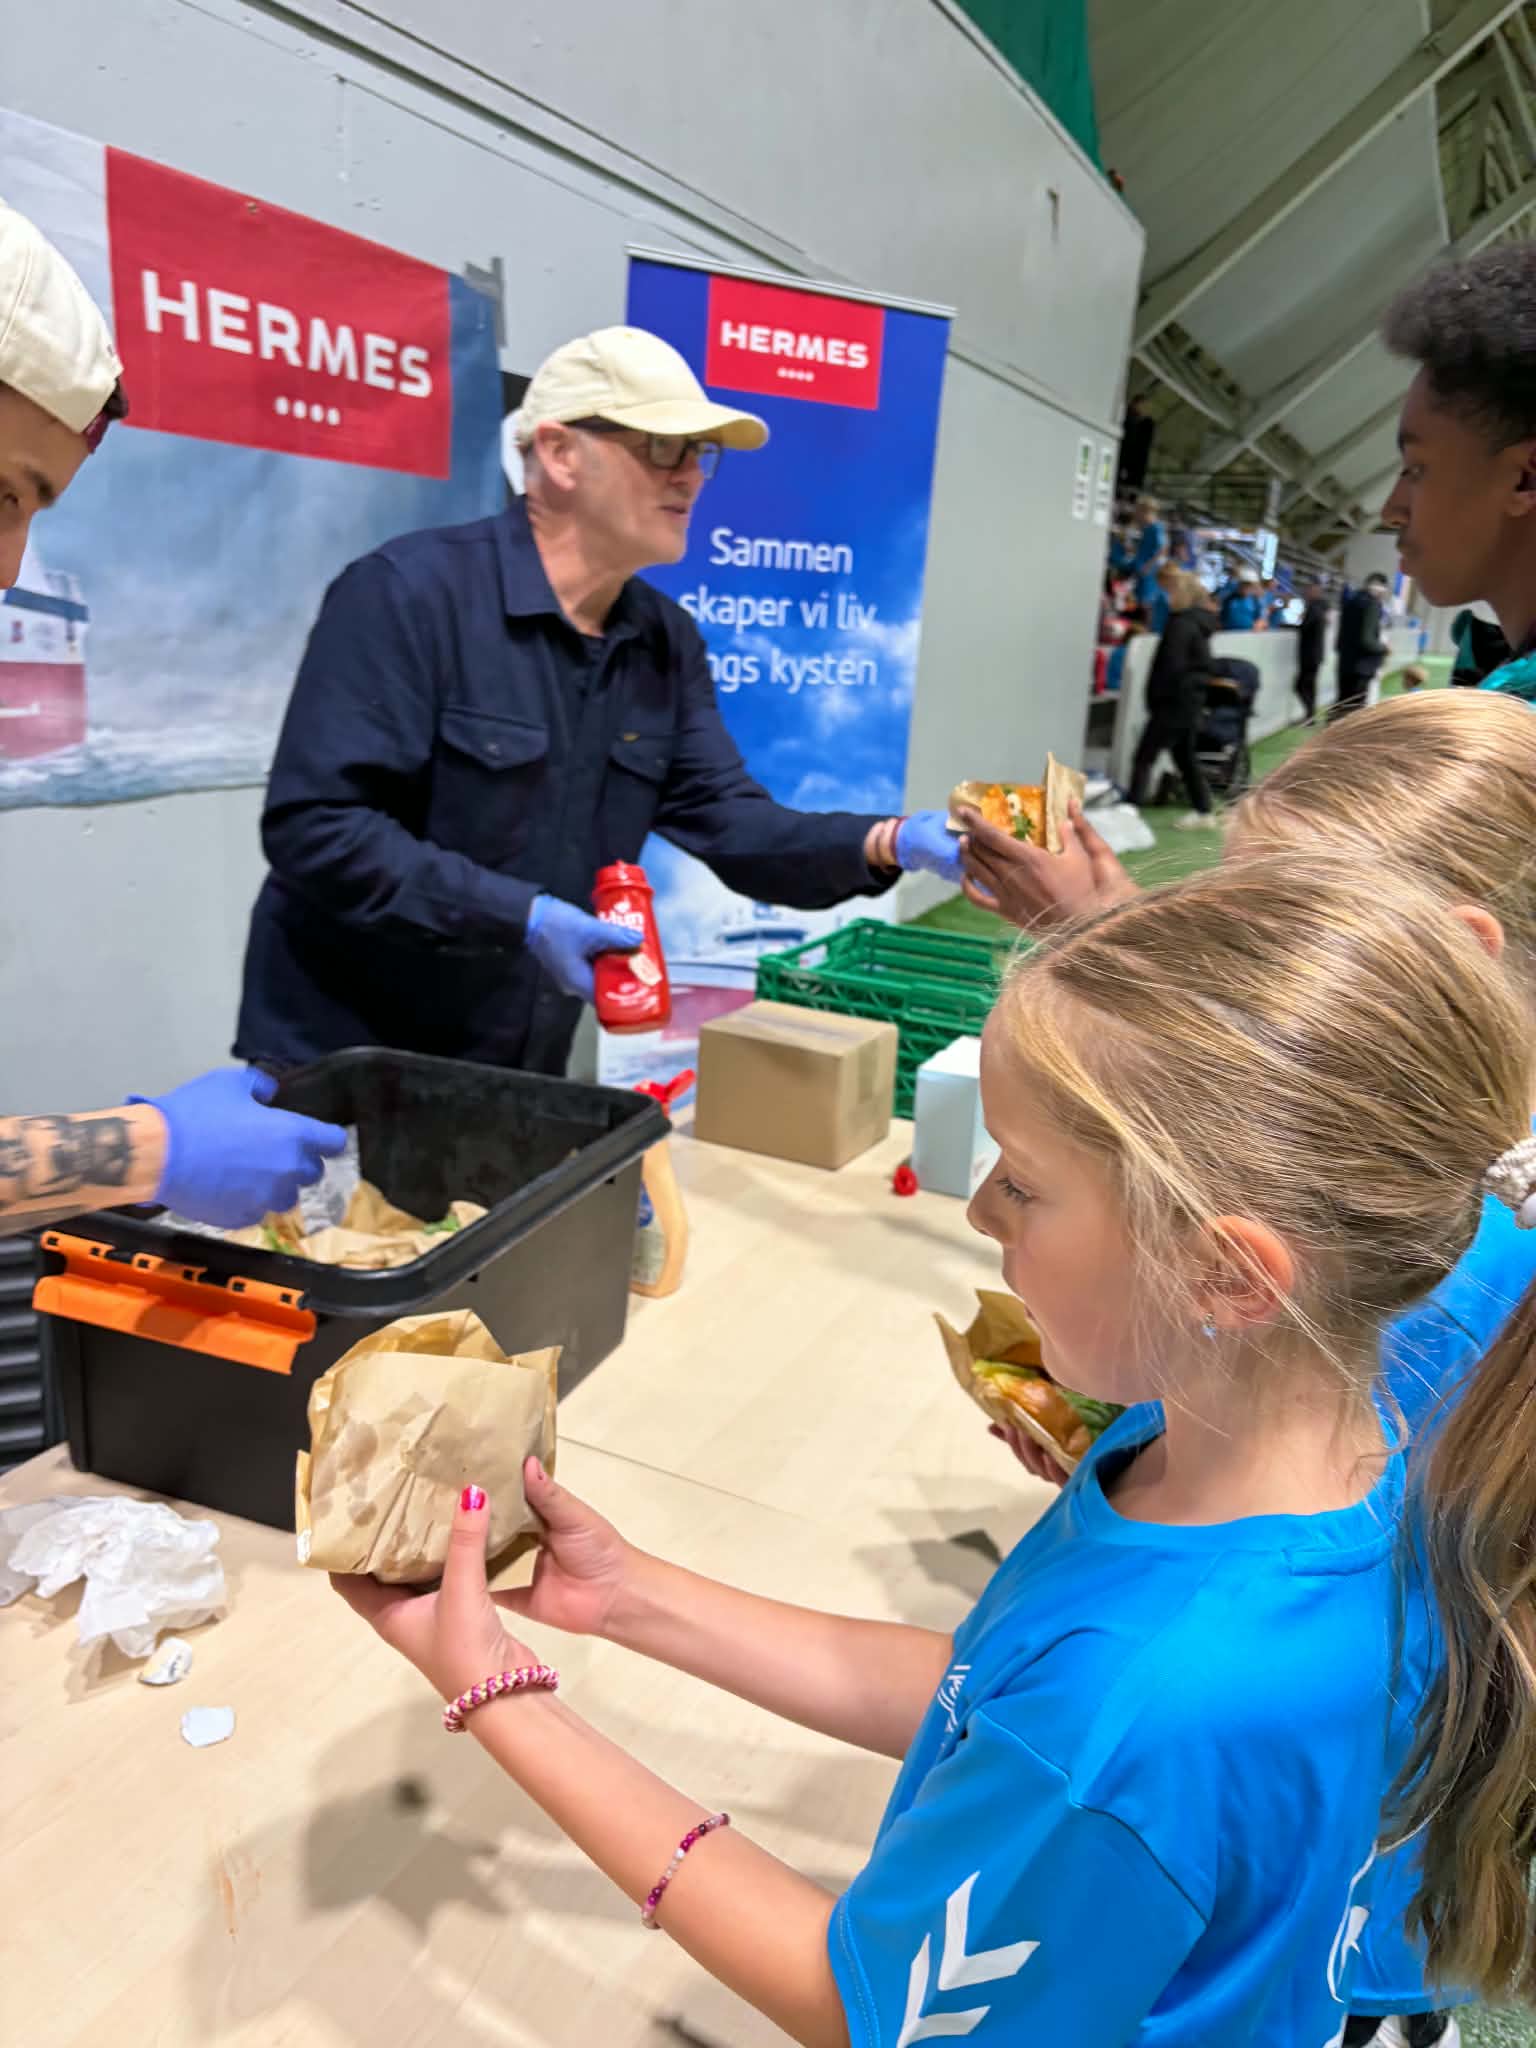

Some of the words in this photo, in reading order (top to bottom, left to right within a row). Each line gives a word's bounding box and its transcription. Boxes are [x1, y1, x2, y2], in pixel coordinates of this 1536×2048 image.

[142, 270, 432, 398] HERMES
[719, 321, 868, 369] HERMES
[710, 527, 853, 574] Sammen
[679, 585, 792, 634] skaper
[800, 590, 829, 629] vi
[836, 592, 877, 631] liv
[707, 653, 760, 693] ngs
[770, 646, 877, 694] kysten
